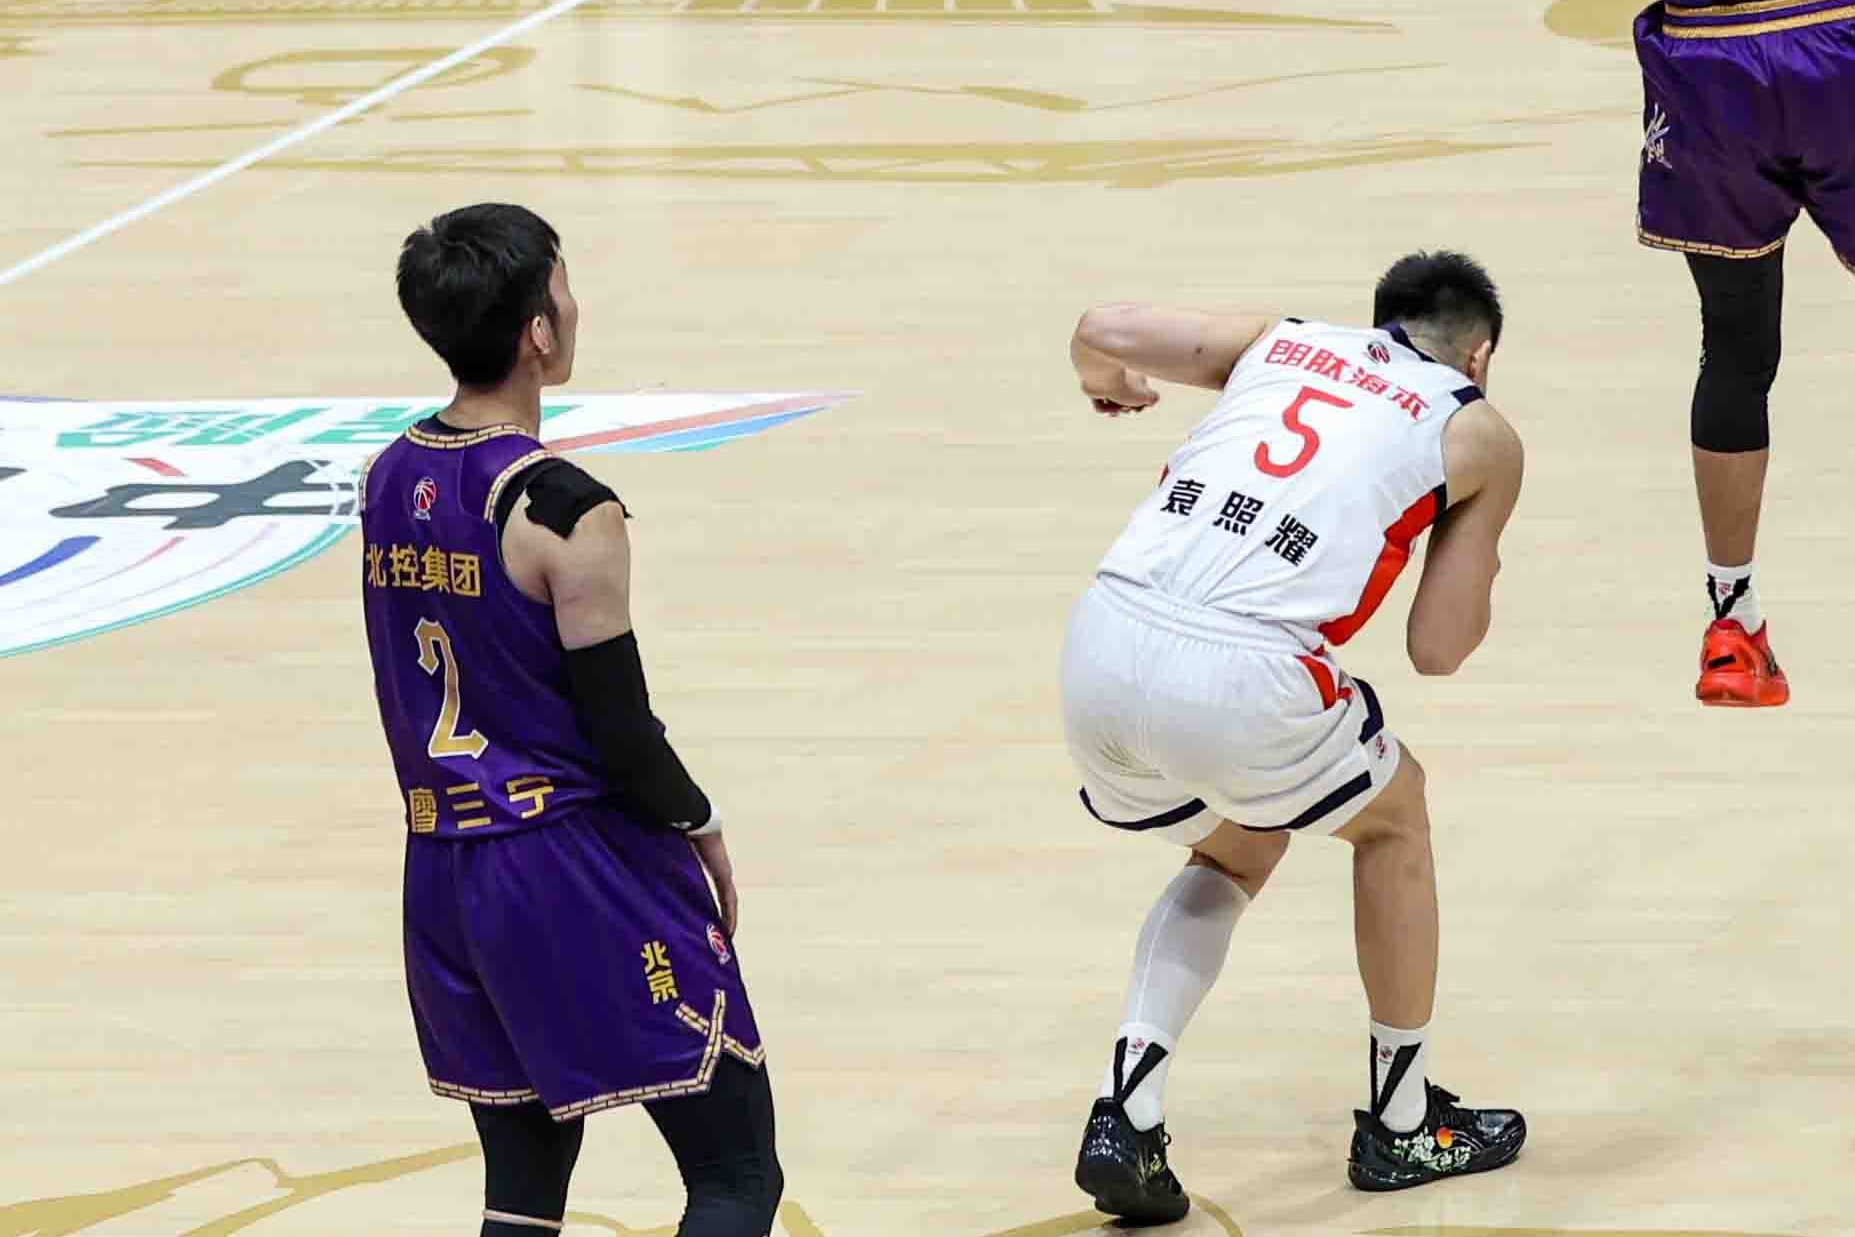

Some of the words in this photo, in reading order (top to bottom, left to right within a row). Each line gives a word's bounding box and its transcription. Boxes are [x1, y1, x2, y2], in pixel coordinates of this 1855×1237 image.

[1253, 385, 1355, 479] 5
[1160, 479, 1319, 568] 袁照耀
[366, 543, 482, 598] 北控集团
[413, 616, 489, 760] 2
[639, 940, 680, 1005] 北京
